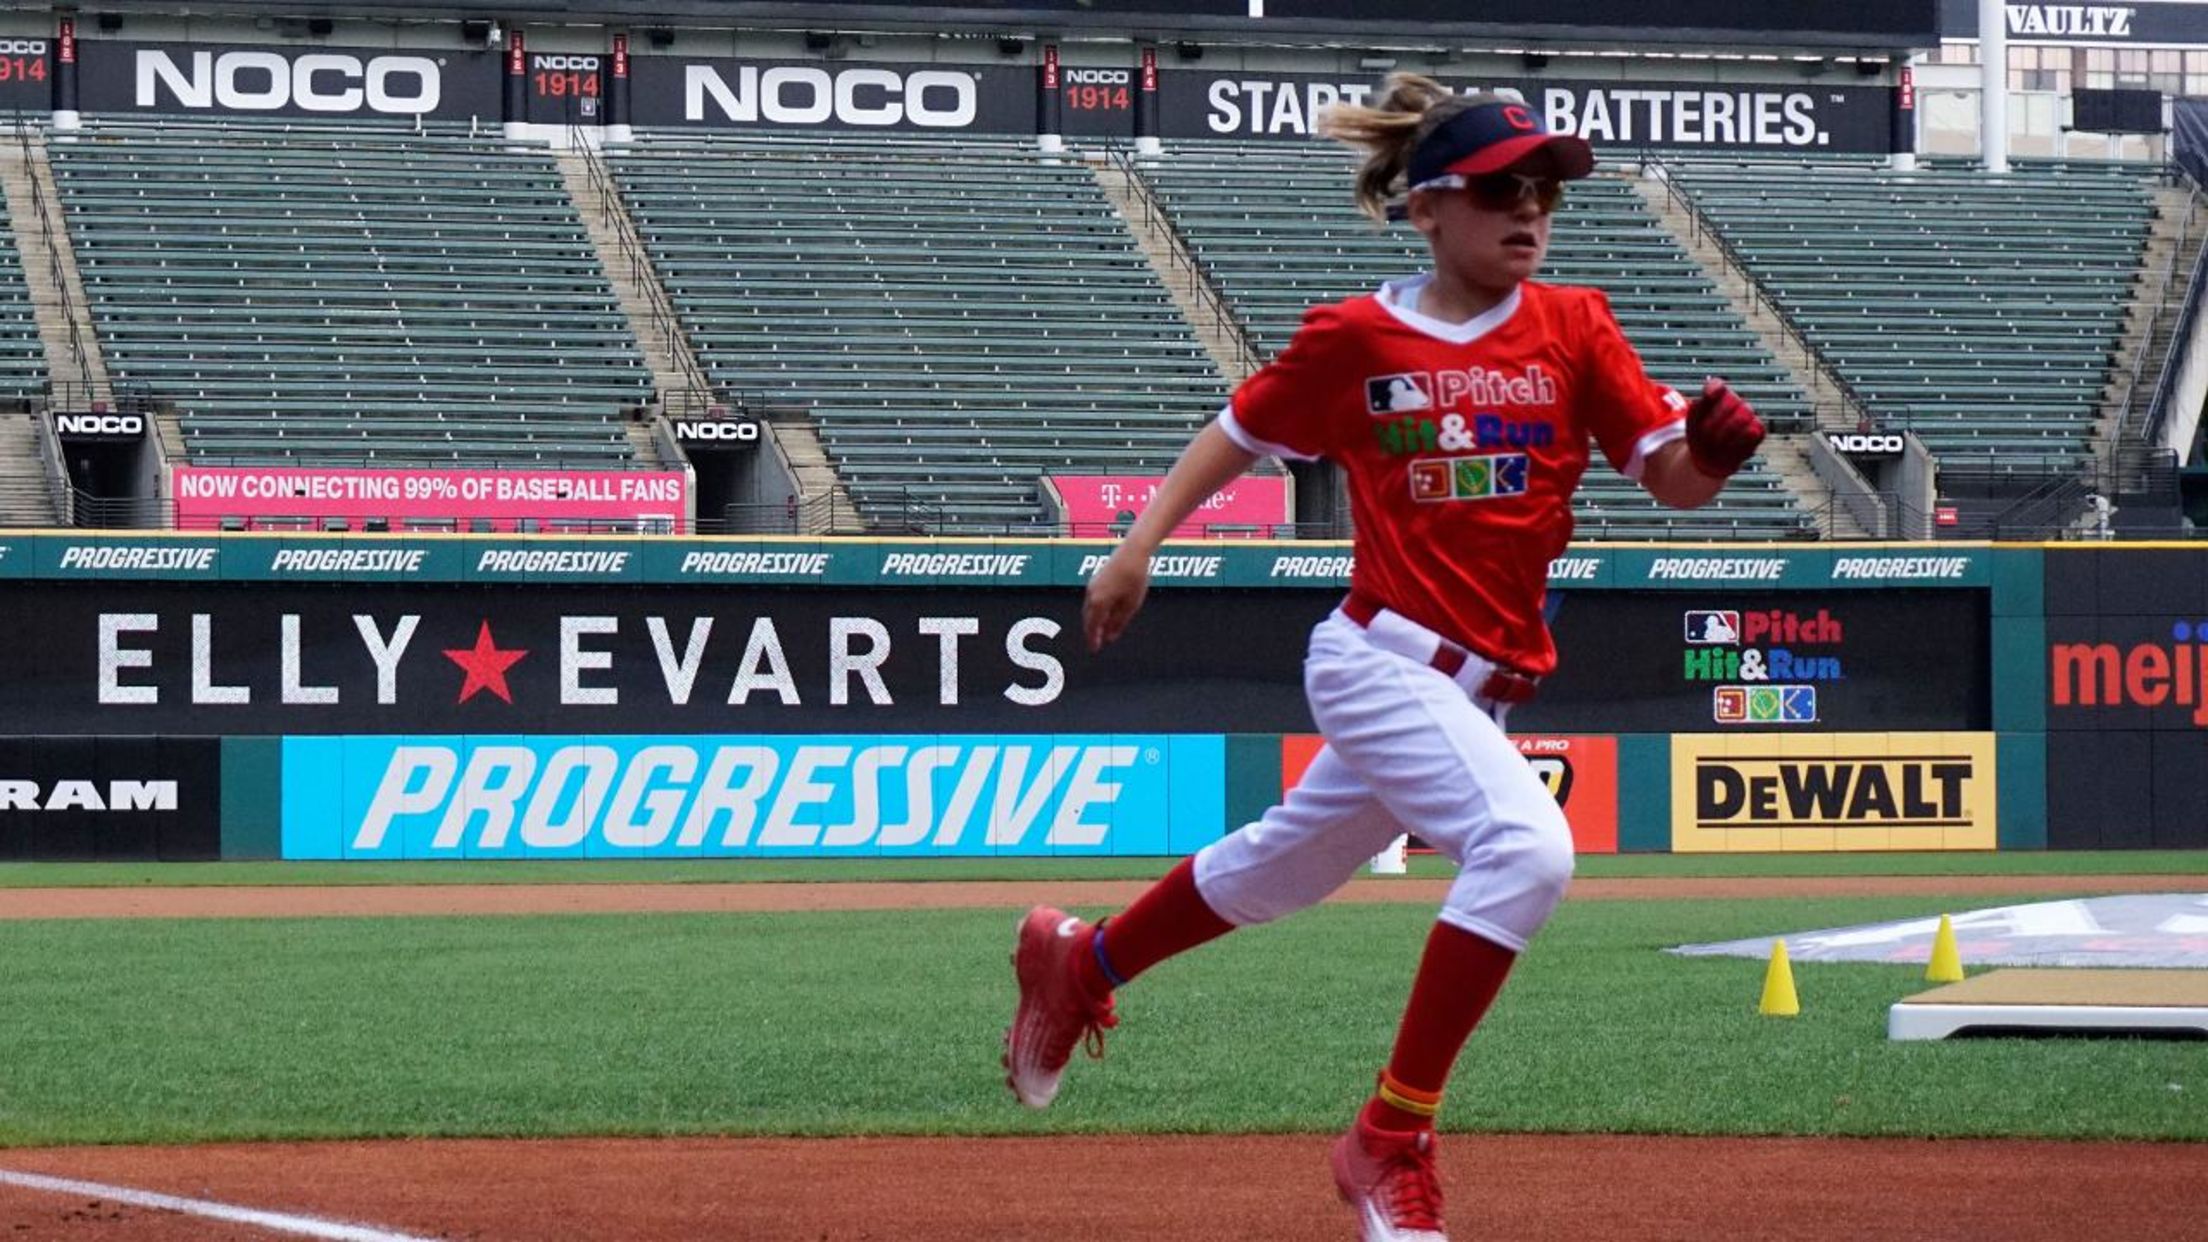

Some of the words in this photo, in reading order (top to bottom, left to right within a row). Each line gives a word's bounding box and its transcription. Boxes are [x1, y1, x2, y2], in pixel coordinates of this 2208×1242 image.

[2005, 6, 2131, 36] VAULTZ
[0, 40, 45, 54] OCO
[0, 58, 45, 81] 914
[534, 55, 599, 70] NOCO
[135, 50, 440, 113] NOCO
[535, 73, 598, 96] 1914
[1066, 70, 1129, 84] NOCO
[685, 65, 977, 127] NOCO
[1067, 87, 1130, 109] 1914
[1545, 88, 1829, 146] BATTERIES.
[1439, 365, 1555, 407] Pitch
[57, 414, 143, 434] NOCO
[676, 422, 758, 440] NOCO
[1828, 434, 1904, 453] NOCO
[181, 475, 239, 498] NOW
[243, 475, 399, 499] CONNECTING
[404, 477, 457, 499] 99%
[462, 478, 493, 500] OF
[500, 478, 616, 500] BASEBALL
[621, 479, 680, 501] FANS
[60, 546, 215, 570] PROGRESSIVE
[271, 550, 424, 572] PROGRESSIVE
[478, 550, 629, 573] PROGRESSIVE
[680, 551, 828, 575] PROGRESSIVE
[881, 553, 1024, 577] PROGRESSIVE
[1649, 558, 1784, 580] PROGRESSIVE
[1831, 557, 1967, 579] PROGRESSIVE
[1744, 609, 1843, 643] Pitch
[98, 613, 421, 704] ELLY
[560, 616, 1065, 705] EVARTS
[2053, 621, 2208, 726] meij
[1535, 740, 1570, 750] PRO
[0, 779, 179, 810] RAM
[351, 744, 1140, 851] PROGRESSIVE
